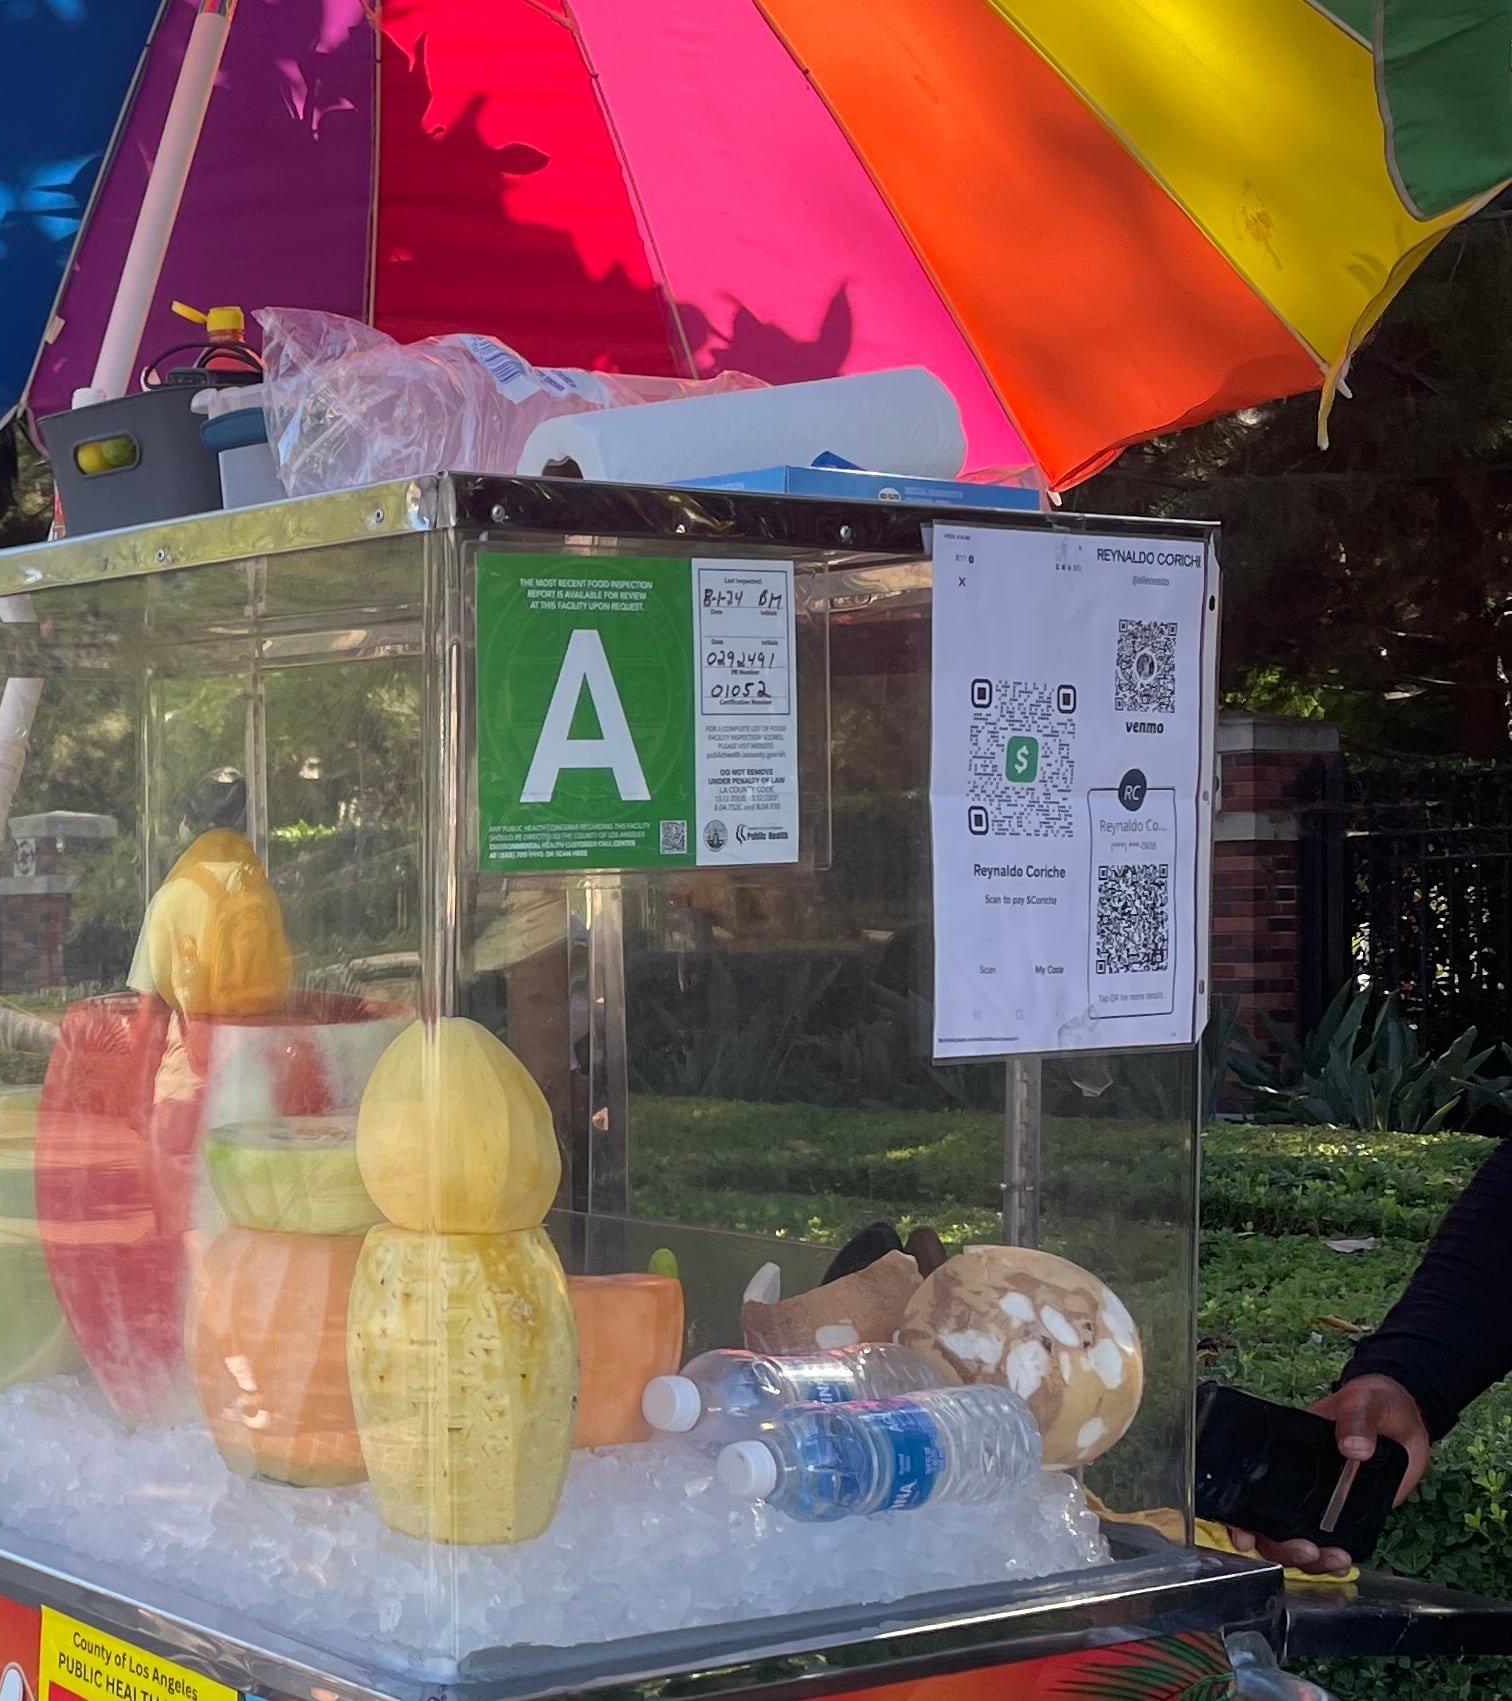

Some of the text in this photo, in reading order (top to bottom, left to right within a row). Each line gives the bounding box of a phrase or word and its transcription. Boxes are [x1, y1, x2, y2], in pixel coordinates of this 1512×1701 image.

[1096, 548, 1155, 565] REYNALDO
[587, 579, 610, 588] FOOD
[610, 580, 653, 589] INSPECTION
[527, 589, 556, 598] REPORT
[557, 590, 564, 598] IS
[565, 590, 603, 599] AVAILABLE
[604, 591, 619, 600] FOR
[529, 600, 539, 609] AT
[541, 601, 557, 609] THIS
[558, 601, 588, 610] FACILITY
[588, 602, 610, 610] UPON
[711, 680, 772, 699] 01052
[520, 629, 652, 803] A
[1125, 721, 1164, 733] venmo
[720, 768, 730, 776] DO
[1123, 785, 1142, 801] RC
[1099, 819, 1144, 836] Reynaldo
[973, 863, 1066, 879] Reynaldo Coriche
[985, 895, 1001, 904] Scan
[1003, 895, 1011, 904] to
[1012, 897, 1025, 906] pay
[58, 1651, 103, 1688] PUBLIC
[72, 1632, 198, 1701] County of Los Angeles
